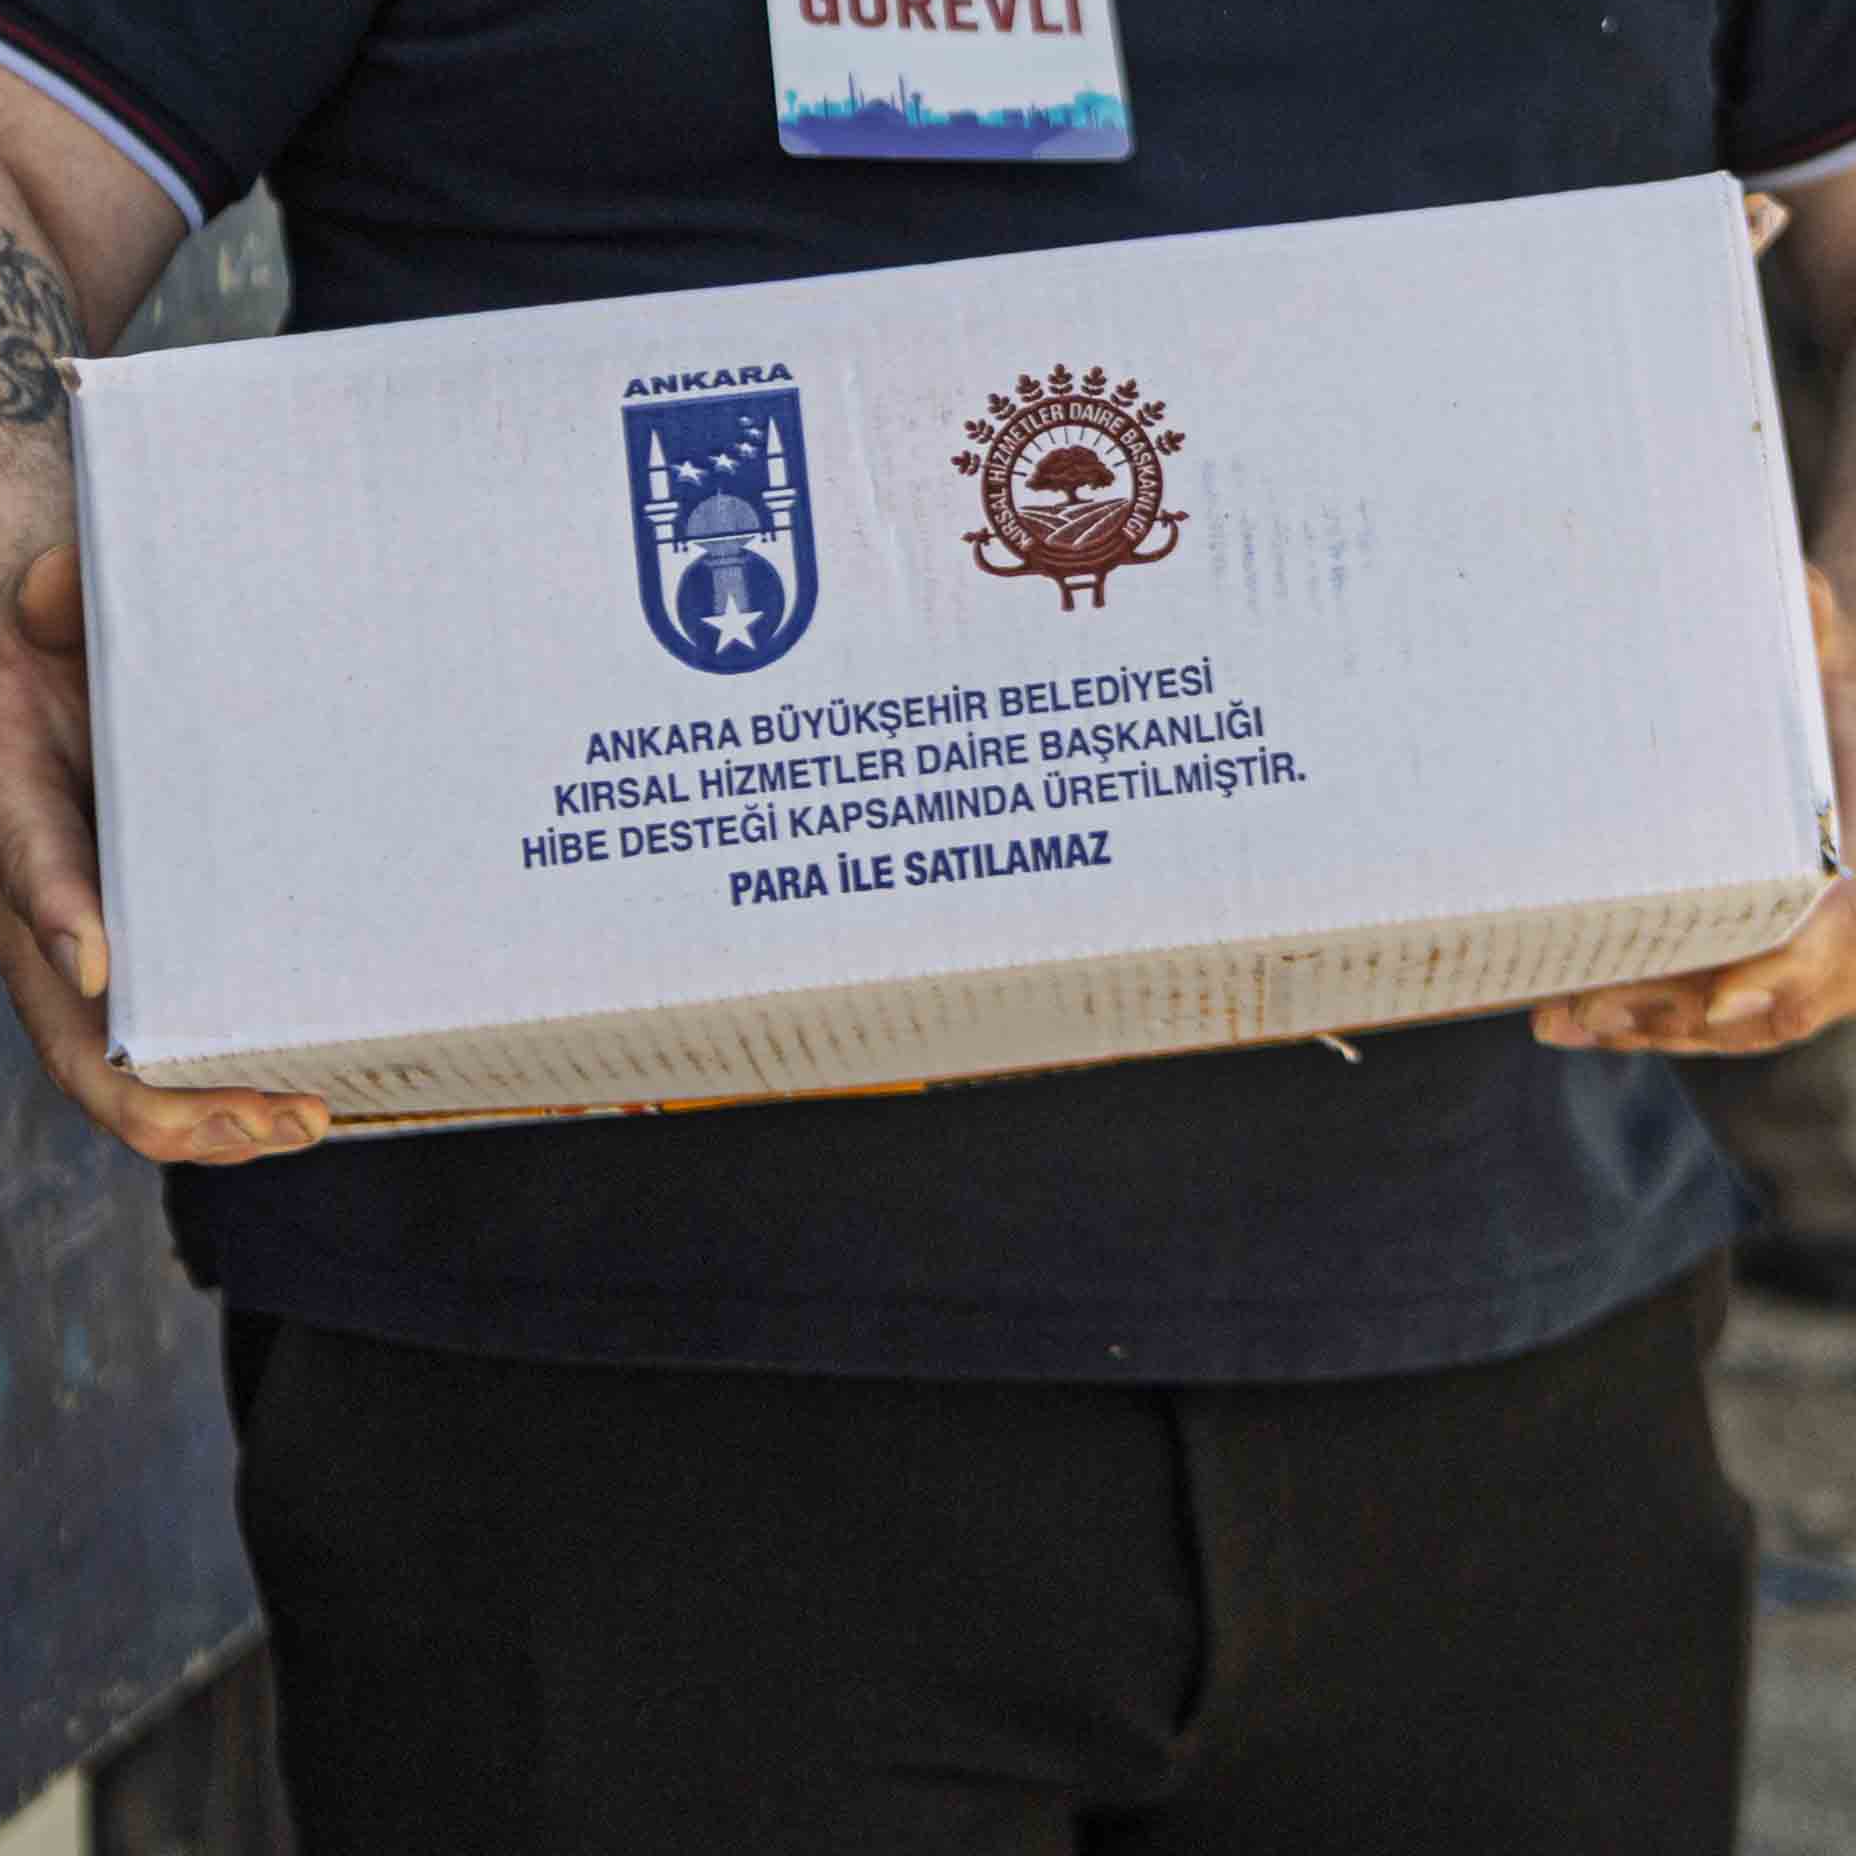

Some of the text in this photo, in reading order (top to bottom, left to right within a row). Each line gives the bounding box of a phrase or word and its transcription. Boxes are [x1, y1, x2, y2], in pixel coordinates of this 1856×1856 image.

[622, 362, 793, 398] ANKARA
[553, 699, 1264, 816] KIRSAL HİZMETLER DAİRE BAŞKANLIĞI
[585, 657, 1213, 765] ANKARA BÜYÜKŞEHİR BELEDİYESİ
[521, 746, 1306, 869] HİBE DESTEĞİ KAPSAMINDA ÜRETİLMİŞTİR.
[728, 829, 1112, 907] PARA İLE SATILAMAZ
